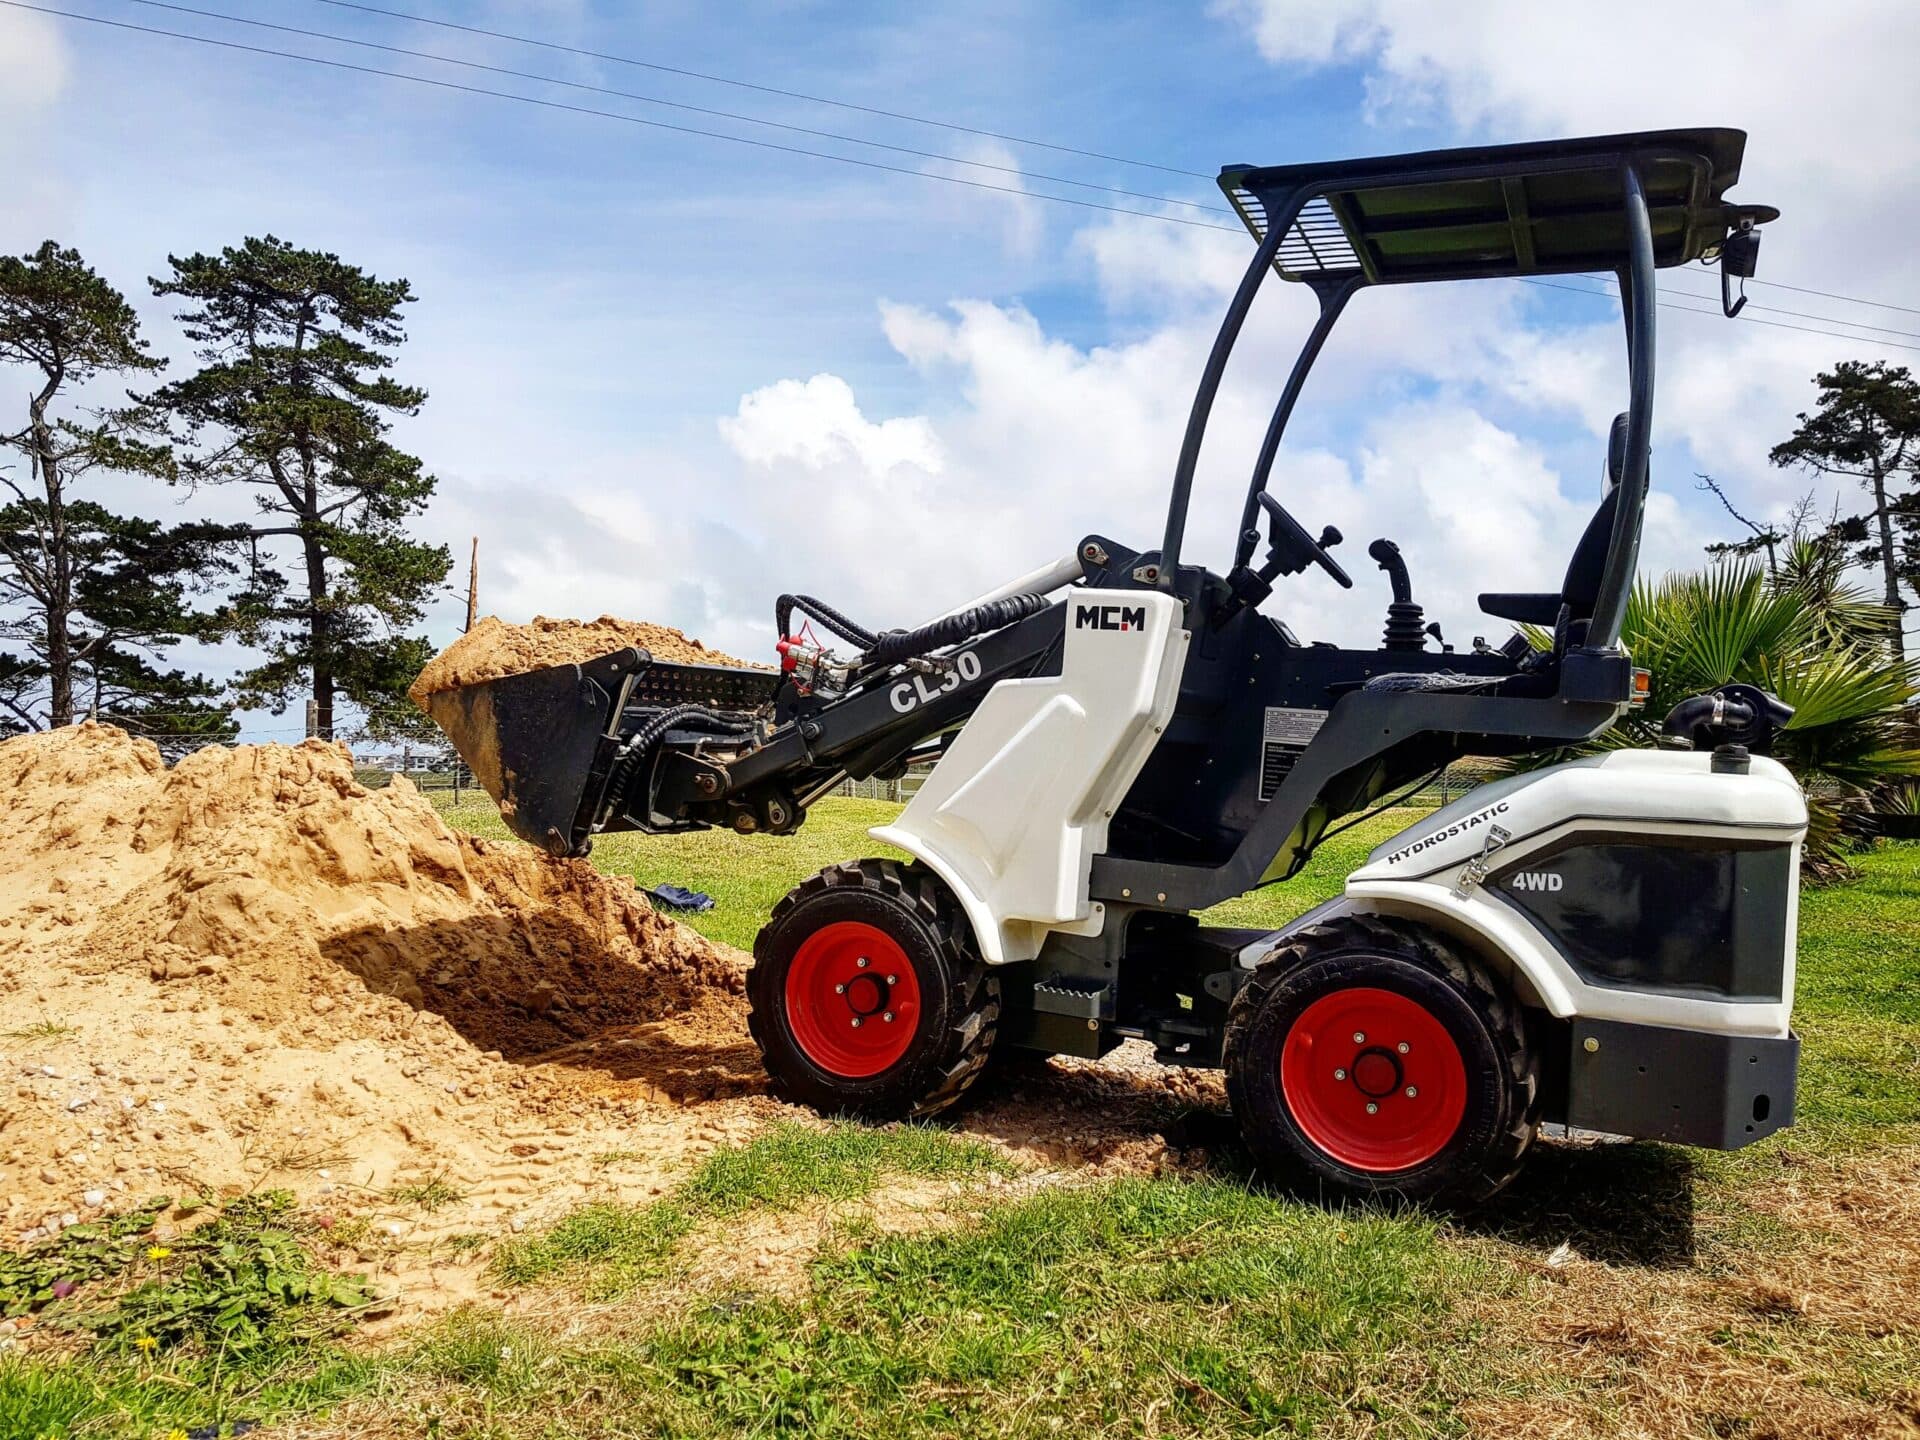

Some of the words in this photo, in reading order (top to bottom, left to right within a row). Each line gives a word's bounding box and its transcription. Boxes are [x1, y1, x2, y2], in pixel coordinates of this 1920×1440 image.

[1076, 605, 1146, 631] MCM
[1388, 802, 1510, 865] HYDROSTATIC
[1512, 872, 1563, 891] 4WD
